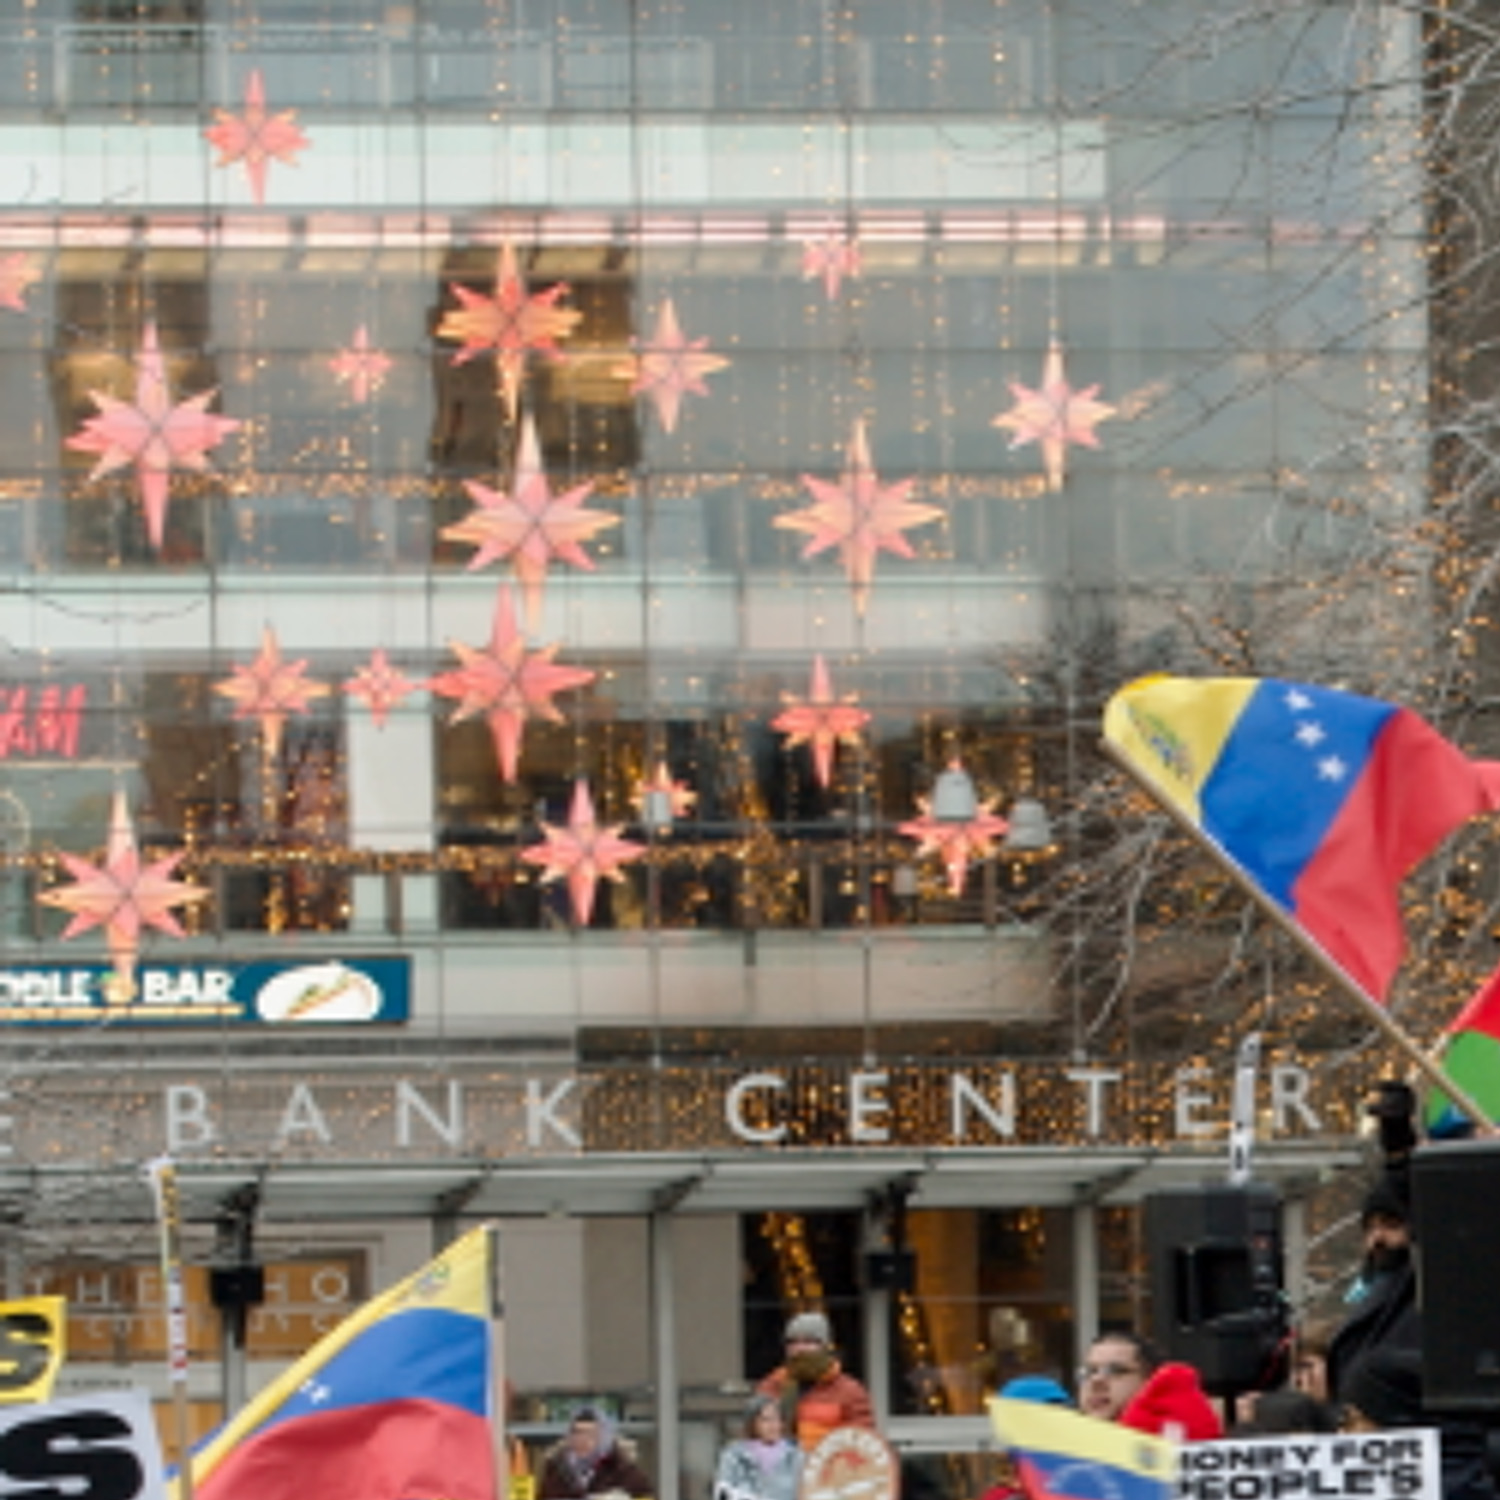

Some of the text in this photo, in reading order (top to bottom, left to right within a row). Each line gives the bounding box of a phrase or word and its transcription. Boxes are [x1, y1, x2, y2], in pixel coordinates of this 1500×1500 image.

[143, 970, 235, 1004] BAR
[166, 1066, 1322, 1153] BANK CENTER
[1332, 1438, 1424, 1466] FOR
